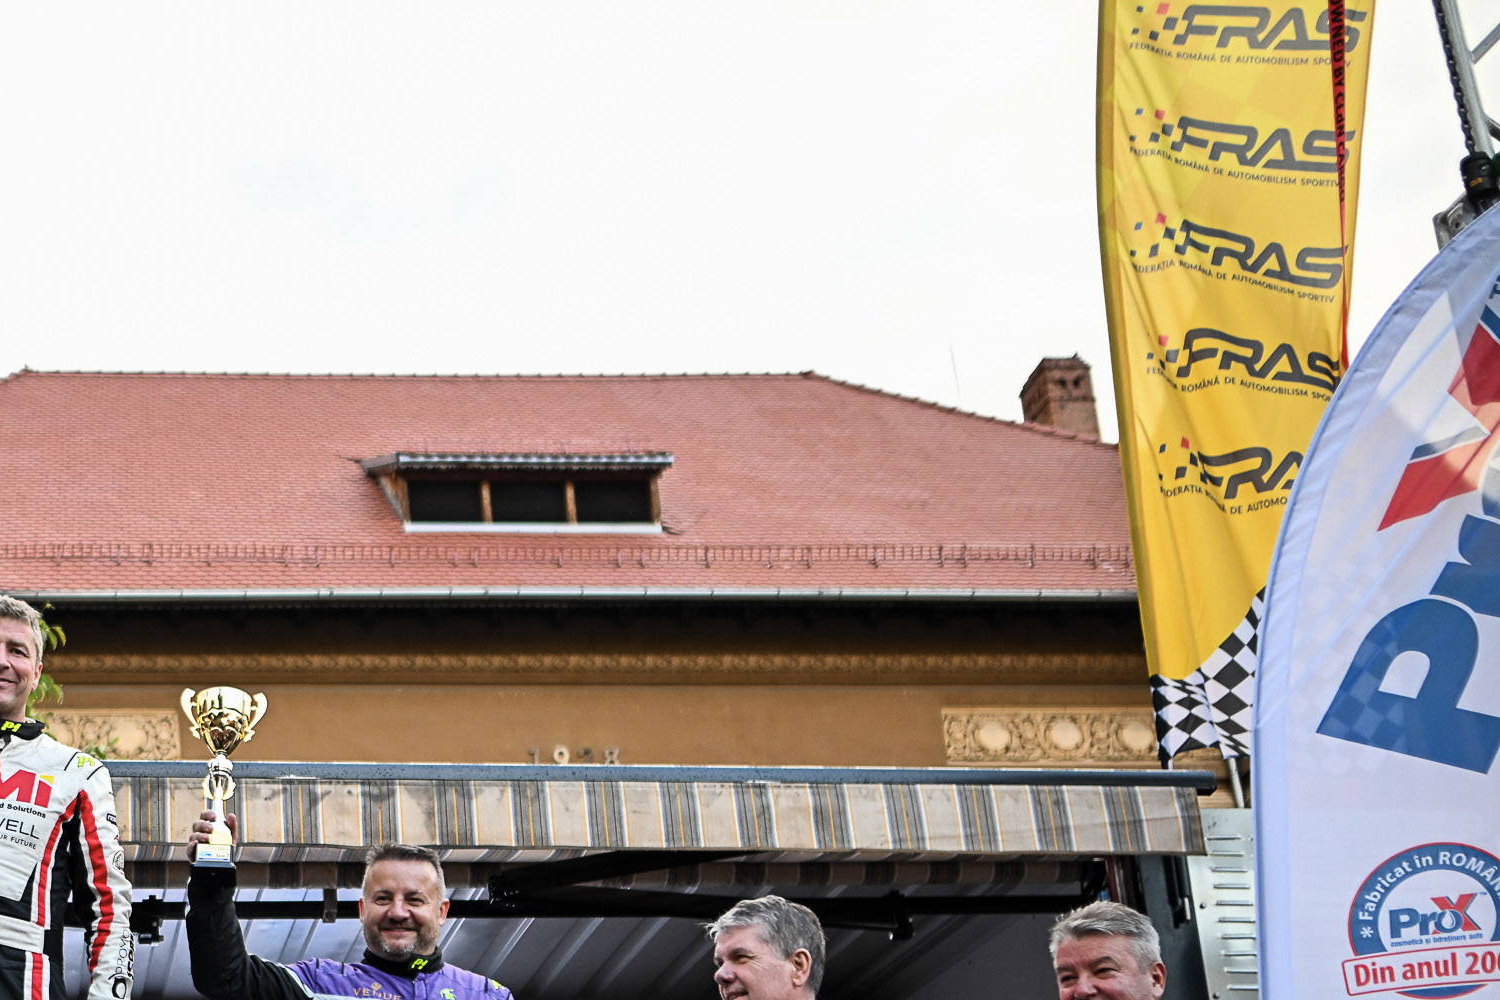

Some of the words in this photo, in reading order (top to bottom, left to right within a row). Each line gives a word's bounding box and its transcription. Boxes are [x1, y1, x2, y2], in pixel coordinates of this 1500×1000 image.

[1173, 4, 1367, 52] FRAS
[1220, 55, 1232, 64] DE
[1236, 55, 1309, 66] AUTOMOBILISM
[1333, 66, 1345, 88] BY
[1171, 116, 1356, 173] FRAS
[1213, 167, 1224, 176] DE
[1227, 169, 1297, 185] AUTOMOBILISM
[1175, 218, 1349, 289] FRAS
[1216, 271, 1228, 280] DE
[1232, 272, 1295, 296] AUTOMOBILISM
[1297, 291, 1335, 304] SPORTIV
[1177, 328, 1340, 394] FRAS
[1224, 375, 1236, 385] DE
[1240, 379, 1309, 397] AUTOMOBILISM
[1230, 505, 1243, 515] DE
[1247, 495, 1288, 513] AUTOMO
[7, 803, 47, 819] Solutions
[11, 836, 37, 850] FUTURE
[1358, 860, 1413, 920] Fabricat
[1414, 854, 1434, 868] în
[1389, 892, 1482, 939] ProX
[1469, 932, 1483, 940] auto
[1354, 961, 1396, 987] Din
[1402, 952, 1459, 981] anul
